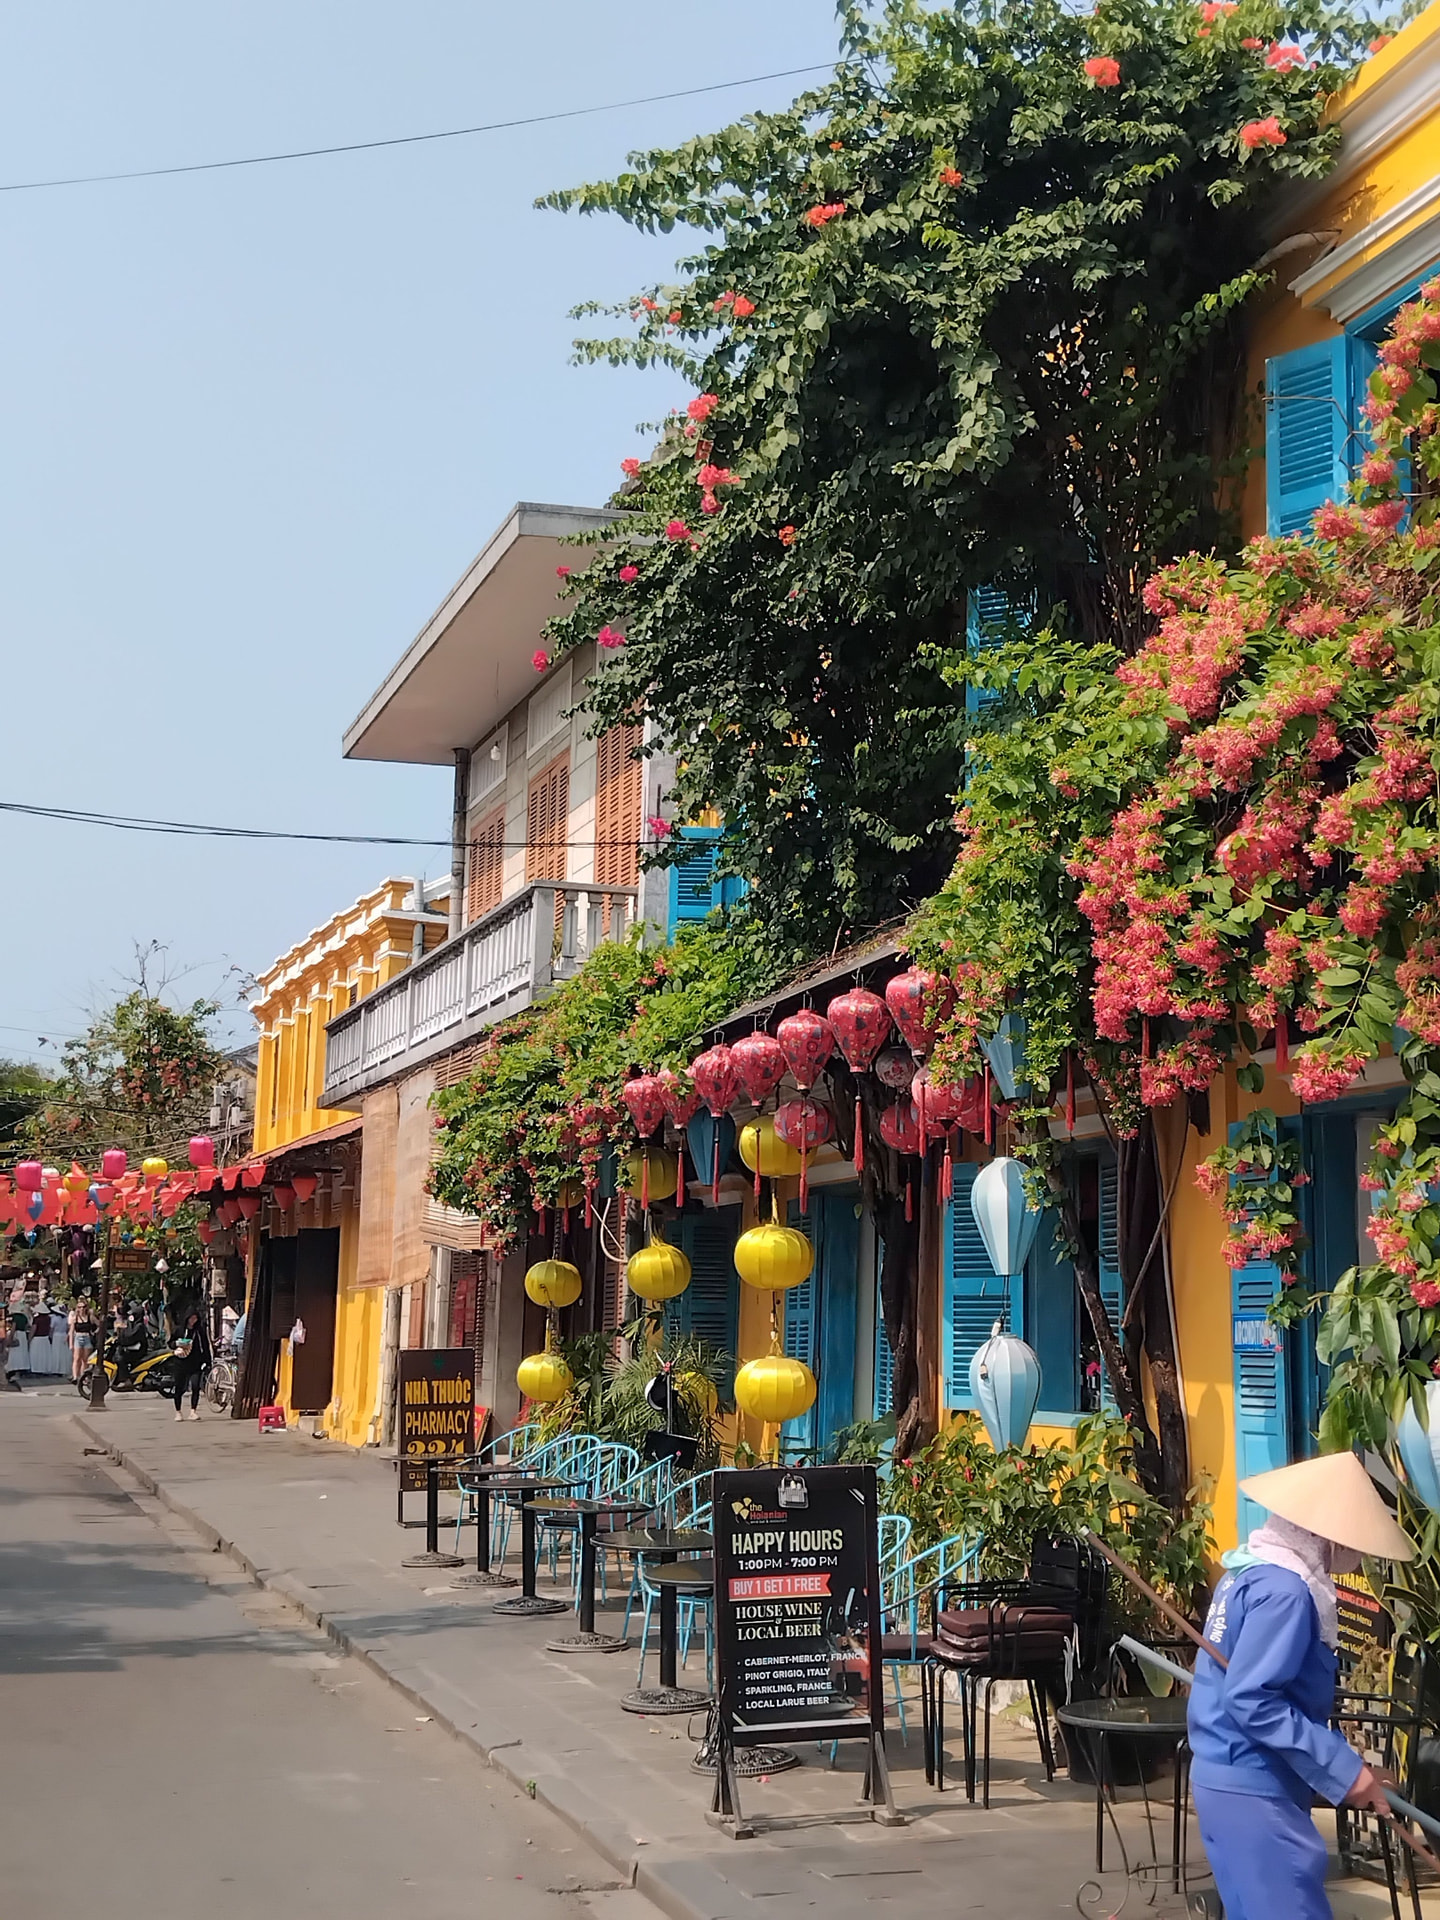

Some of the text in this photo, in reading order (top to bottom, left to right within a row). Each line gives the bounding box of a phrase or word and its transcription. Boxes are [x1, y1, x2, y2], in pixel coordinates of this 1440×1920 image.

[405, 1372, 471, 1405] NHÀ THUỐC
[405, 1410, 470, 1435] PHARMACY
[749, 1503, 763, 1512] the
[732, 1529, 843, 1555] HAPPY HOURS
[790, 1557, 816, 1568] 7:00
[819, 1556, 838, 1566] PM
[733, 1577, 821, 1596] BUY 1 GET 1 FREE
[736, 1602, 823, 1619] HOUSE WINE
[737, 1623, 822, 1640] LOCAL BEER
[744, 1653, 829, 1666] CABERNET-MERLOT,
[745, 1668, 831, 1681] PINOT GRIGIO, ITALY
[745, 1682, 832, 1695] SPARKLING, FRANCE
[746, 1696, 830, 1709] LOCAL LARUE BEER
